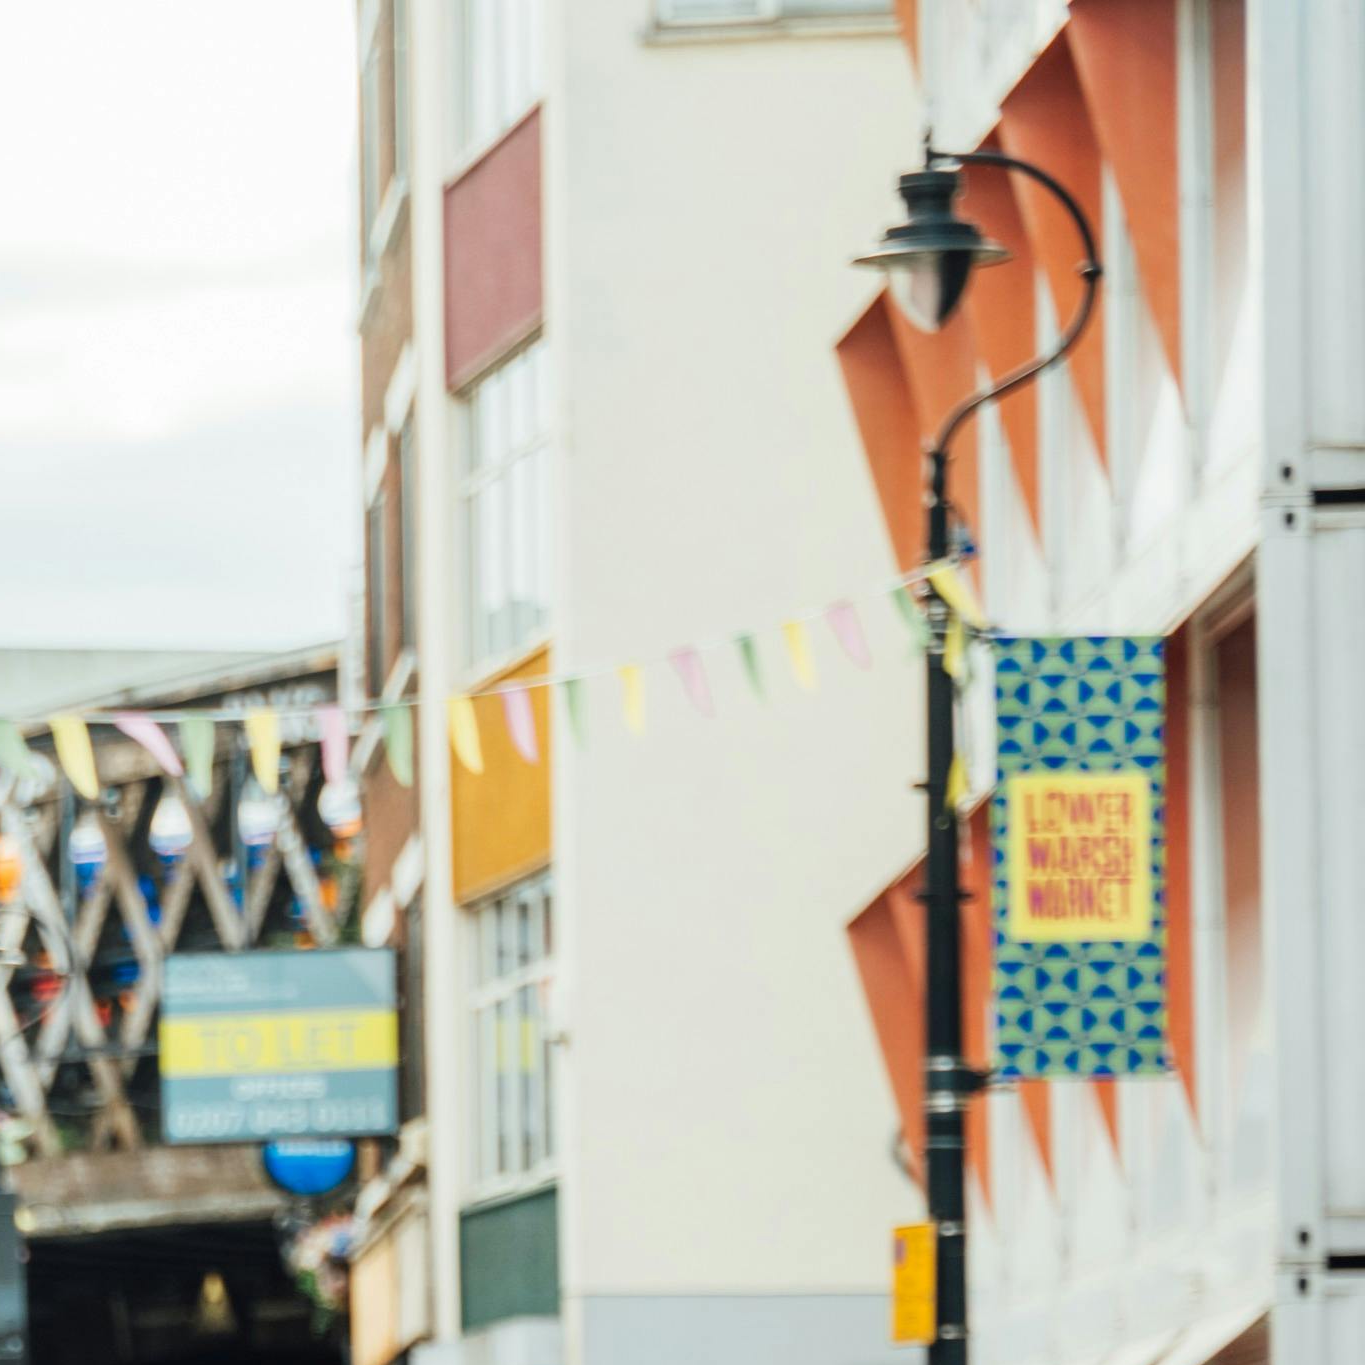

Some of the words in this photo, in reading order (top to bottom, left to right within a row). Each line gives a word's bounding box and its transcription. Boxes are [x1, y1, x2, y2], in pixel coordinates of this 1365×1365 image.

[1024, 792, 1131, 833] LOWER
[1027, 878, 1132, 921] MARKET
[199, 1026, 262, 1068] TO
[276, 1023, 359, 1066] LET
